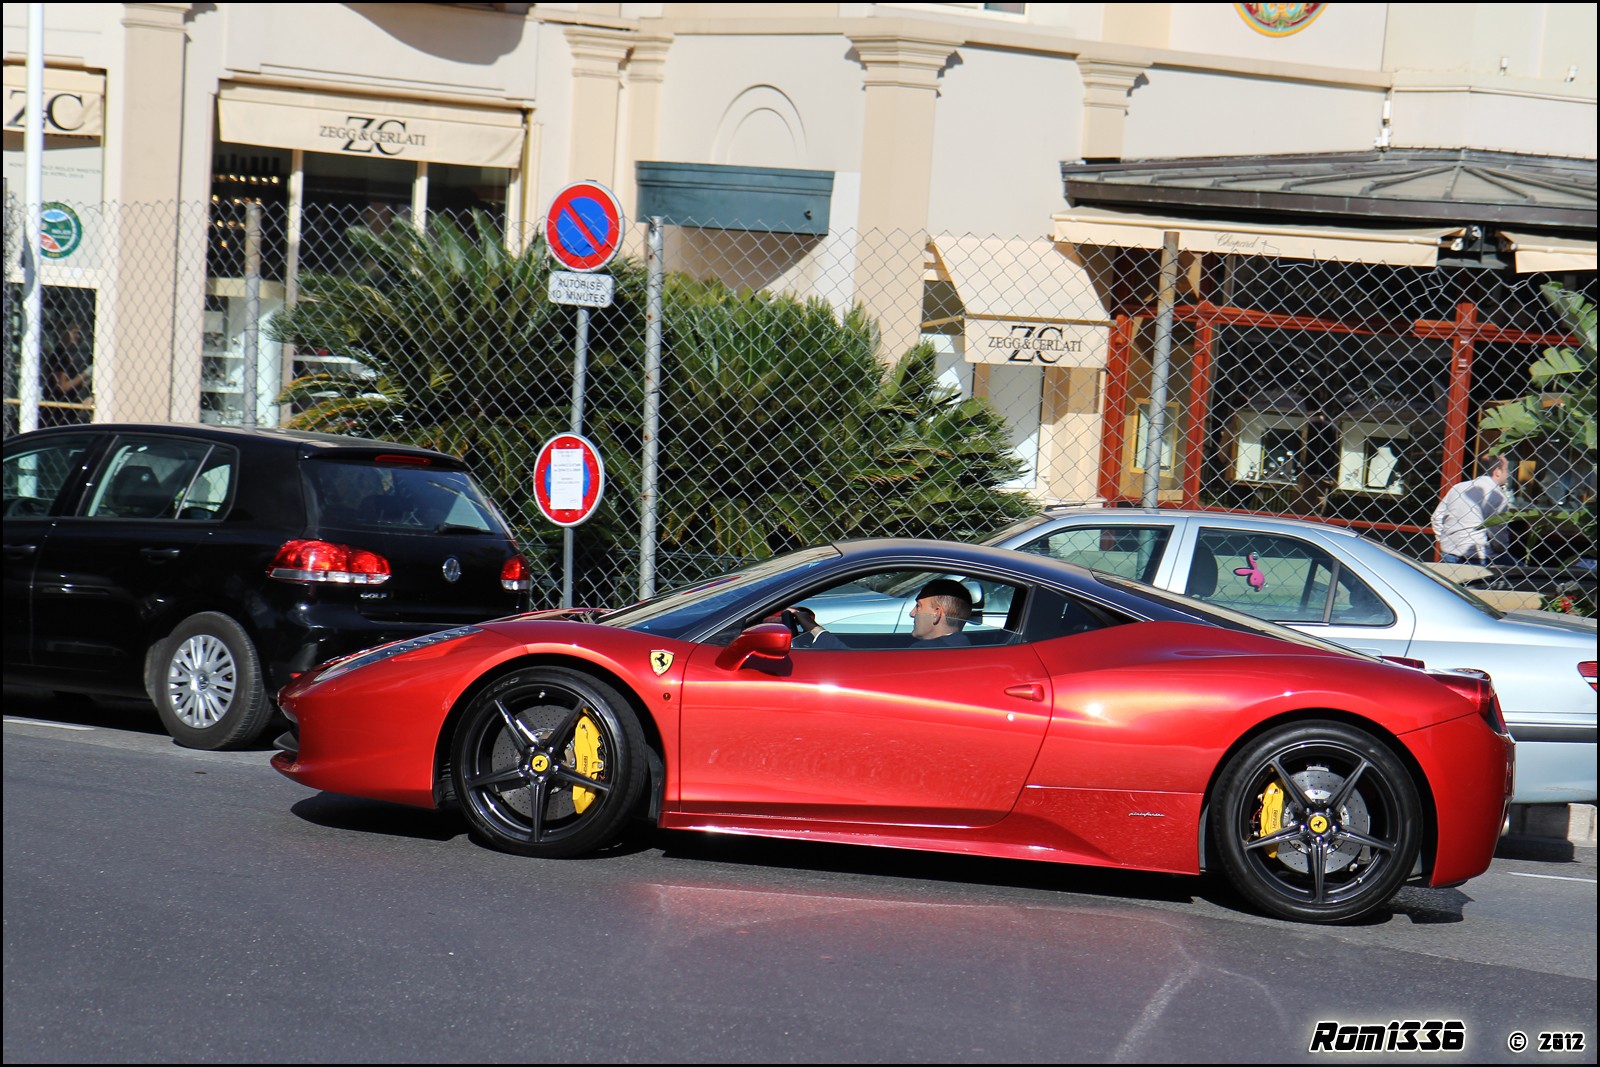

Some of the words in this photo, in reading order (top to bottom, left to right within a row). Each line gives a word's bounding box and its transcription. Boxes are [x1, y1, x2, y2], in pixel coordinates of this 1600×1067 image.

[342, 116, 407, 156] ZC
[1215, 232, 1260, 251] Chopard
[566, 291, 605, 303] MINUTES
[1008, 325, 1063, 364] ZC
